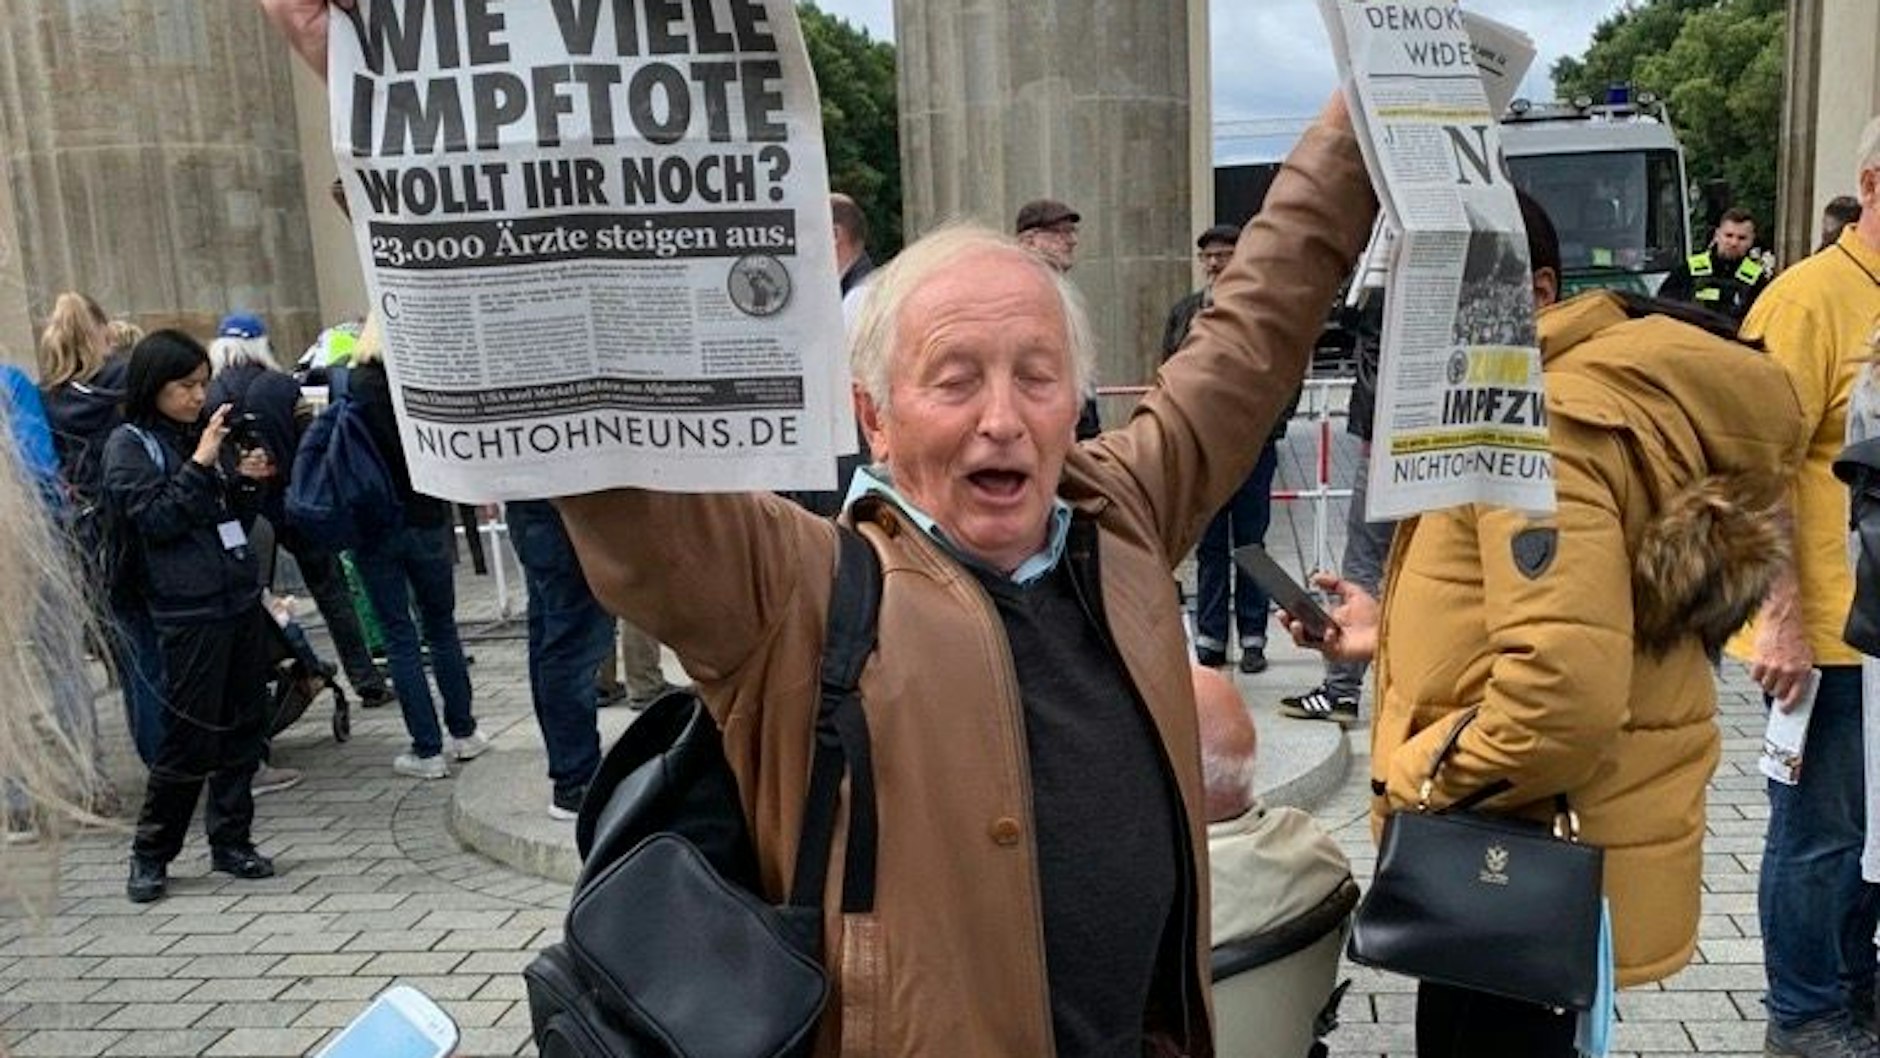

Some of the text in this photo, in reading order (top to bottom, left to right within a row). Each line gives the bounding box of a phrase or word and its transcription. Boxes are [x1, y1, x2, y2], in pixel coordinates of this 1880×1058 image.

[344, 0, 777, 75] WIE VIELE
[1366, 5, 1465, 30] DEMOK
[351, 60, 788, 157] IMPFTOTE
[355, 145, 791, 216] WOLLT IHR NOCH?
[371, 221, 795, 267] 23.000 Ärzte steigen aus.
[416, 416, 797, 460] NICHTOHNEUNS.DE
